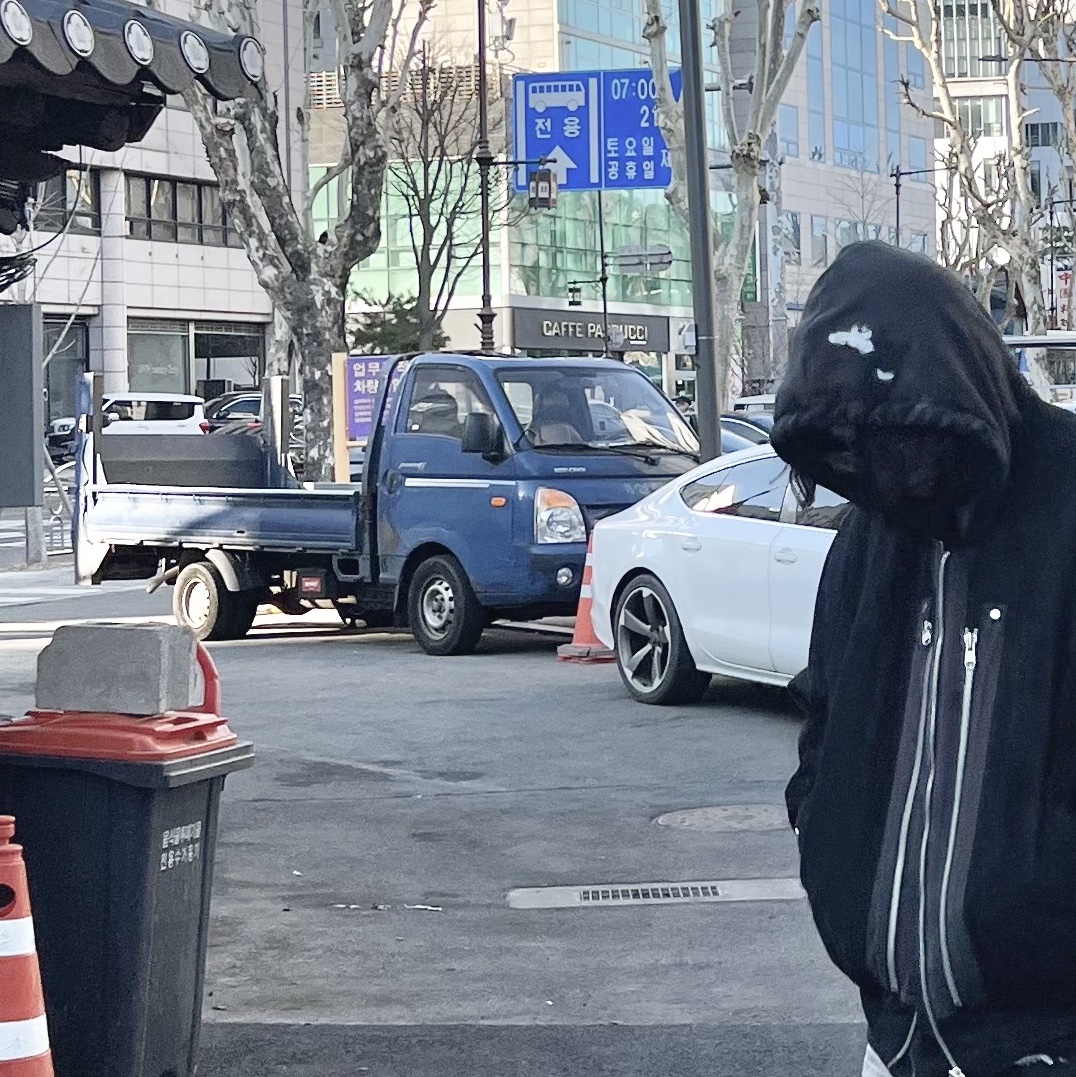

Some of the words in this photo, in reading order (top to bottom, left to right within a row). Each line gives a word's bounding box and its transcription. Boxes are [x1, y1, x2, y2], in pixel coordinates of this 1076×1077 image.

[534, 116, 582, 139] 전용
[606, 136, 655, 157] 토요일
[607, 159, 655, 181] 공휴일
[543, 320, 584, 337] CAFFE
[587, 323, 649, 340] PAUCCI
